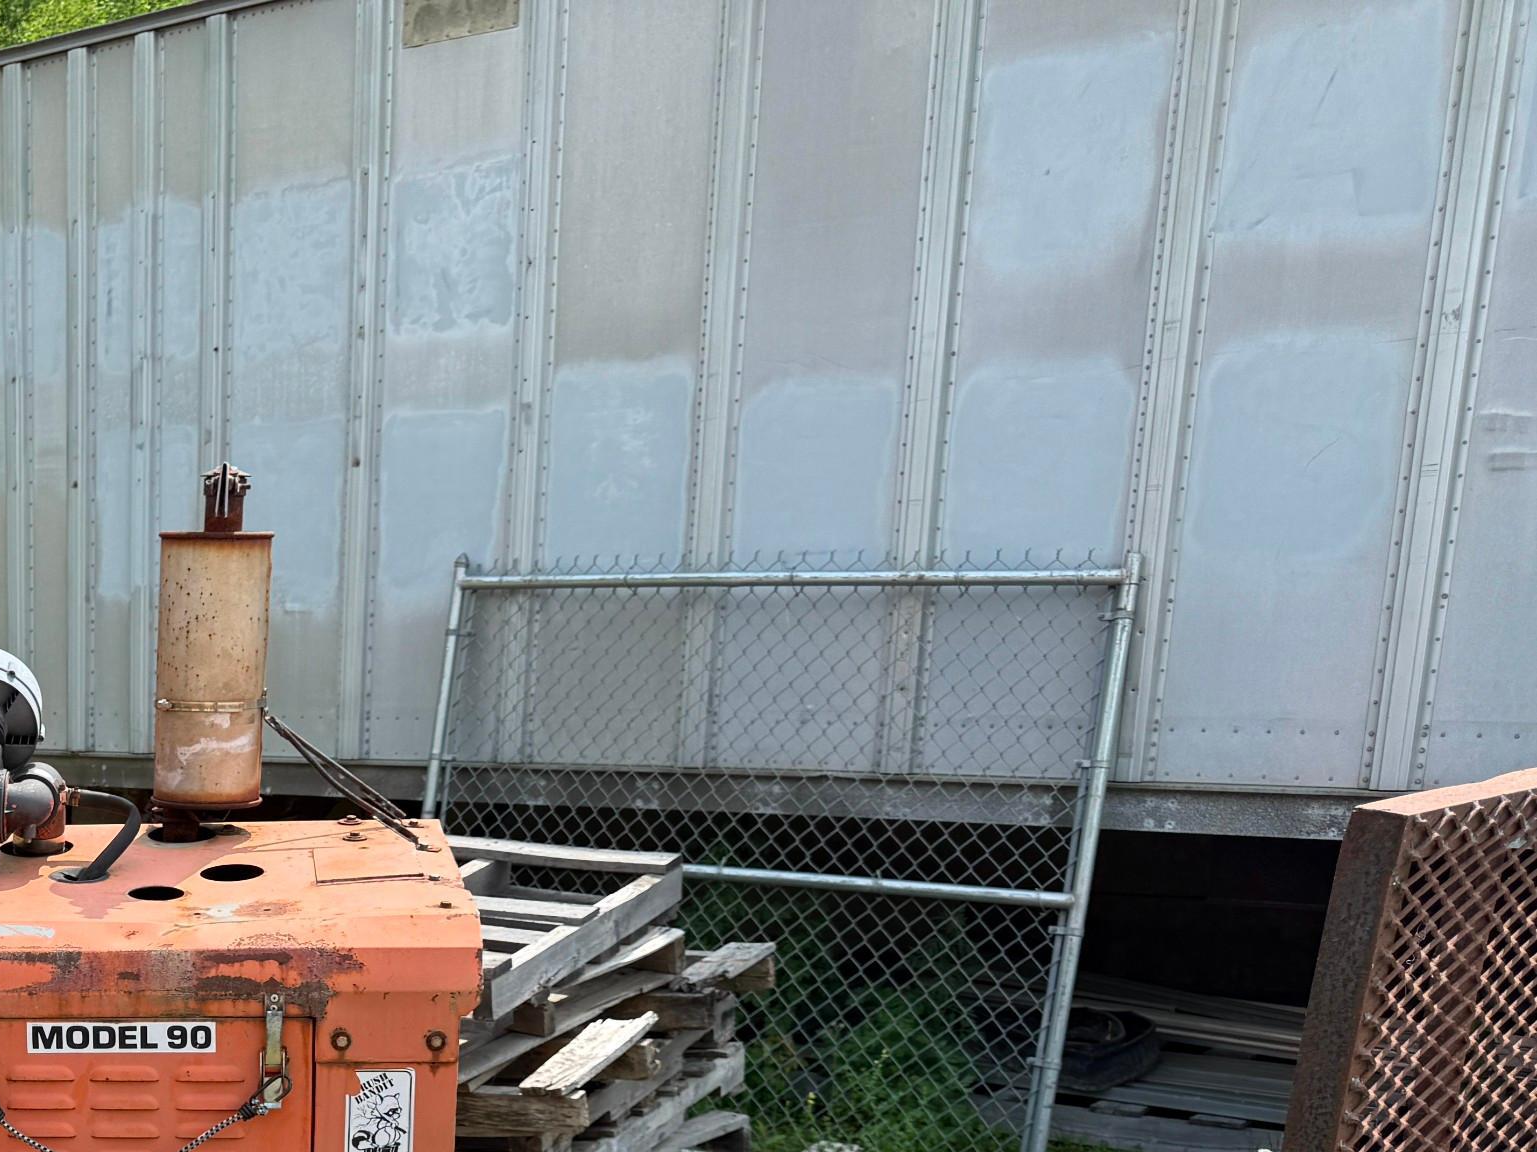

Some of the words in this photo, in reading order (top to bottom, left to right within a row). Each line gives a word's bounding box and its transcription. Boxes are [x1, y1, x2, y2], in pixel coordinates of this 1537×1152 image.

[31, 1025, 159, 1050] MODEL
[166, 1025, 212, 1050] 90
[355, 1078, 394, 1104] BANDIT
[360, 1073, 388, 1092] RUSH
